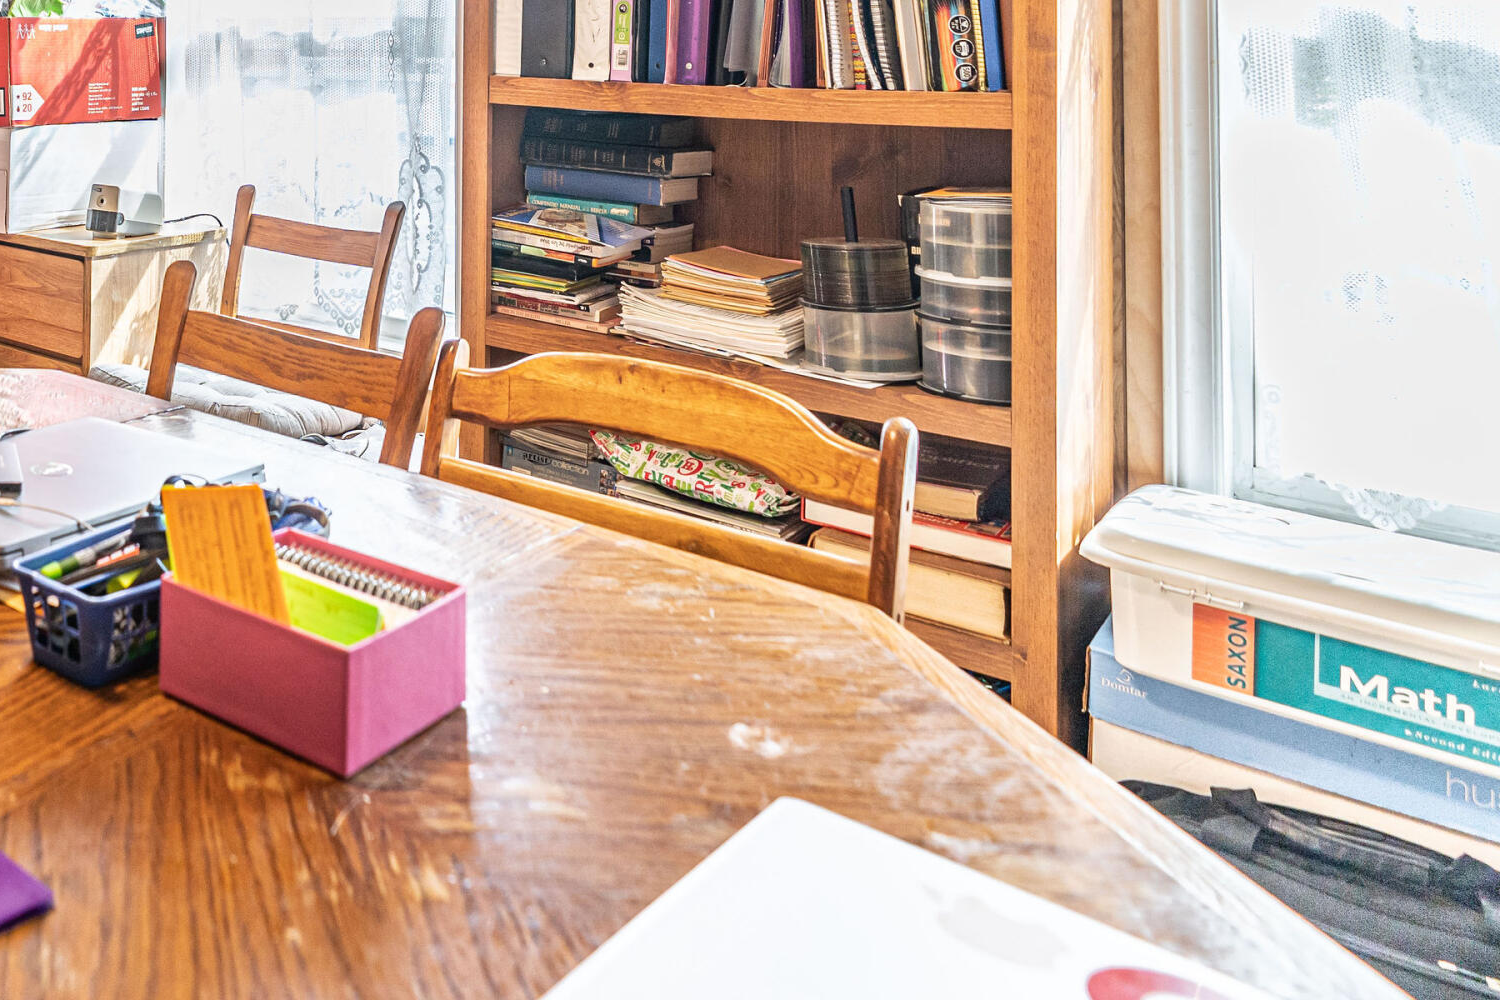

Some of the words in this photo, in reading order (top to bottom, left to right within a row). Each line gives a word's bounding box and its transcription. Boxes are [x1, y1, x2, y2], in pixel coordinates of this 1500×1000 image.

[22, 91, 33, 101] 92
[22, 103, 33, 113] 20
[551, 458, 589, 476] collection
[1227, 616, 1248, 689] SAXON
[1101, 676, 1147, 699] Domtar
[1340, 664, 1476, 727] Math
[1414, 730, 1466, 752] Second
